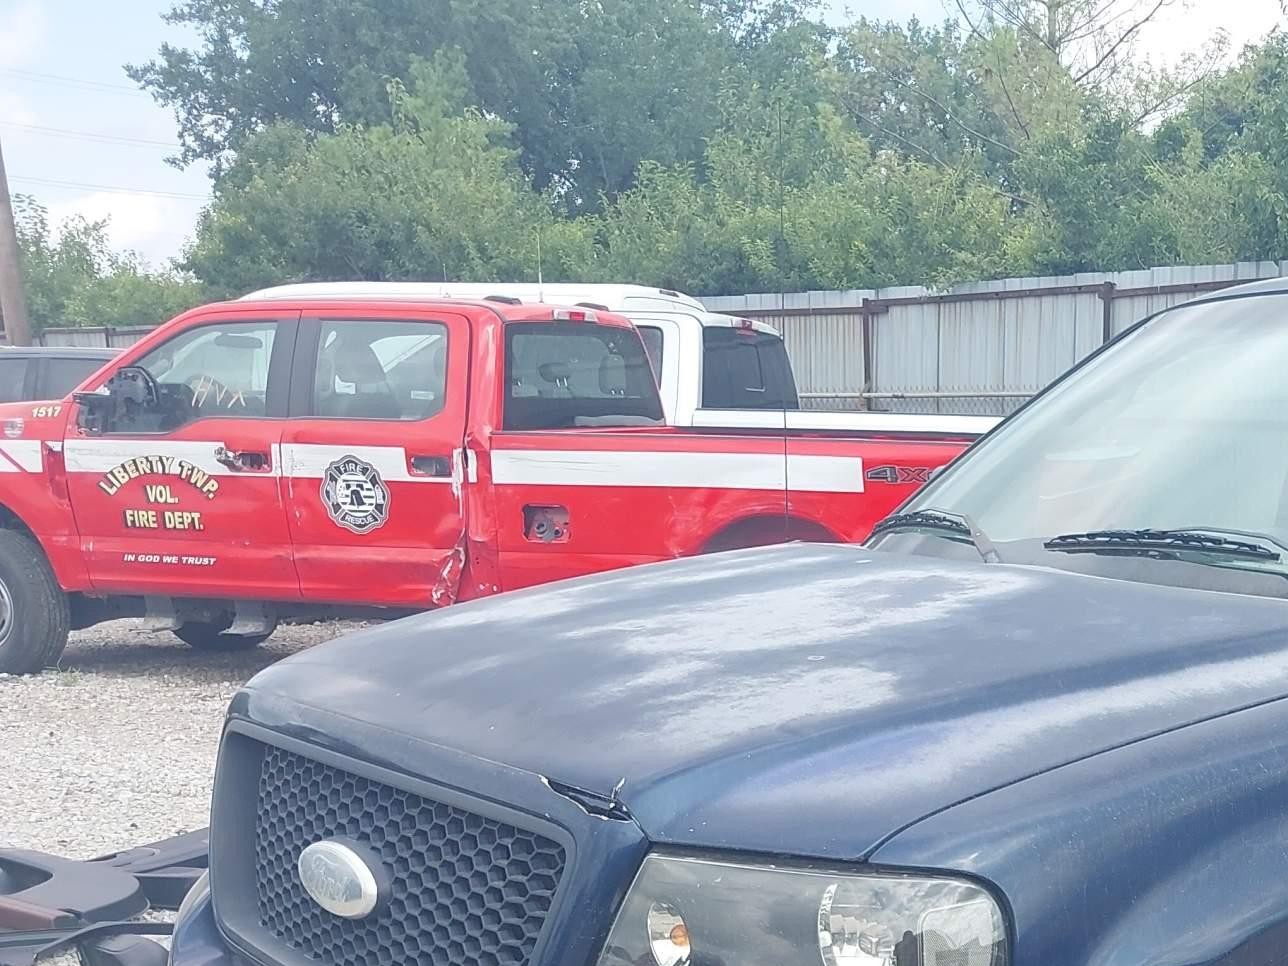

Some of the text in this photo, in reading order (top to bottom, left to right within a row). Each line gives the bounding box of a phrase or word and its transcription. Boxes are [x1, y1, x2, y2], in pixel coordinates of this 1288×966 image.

[340, 462, 363, 474] FIRE
[99, 455, 219, 499] LIBERTY TWP.
[145, 484, 179, 504] VOL.
[124, 509, 204, 530] FIRE DEPT.
[344, 514, 374, 525] RESCUE
[123, 553, 217, 566] IN GOD WE TRUST
